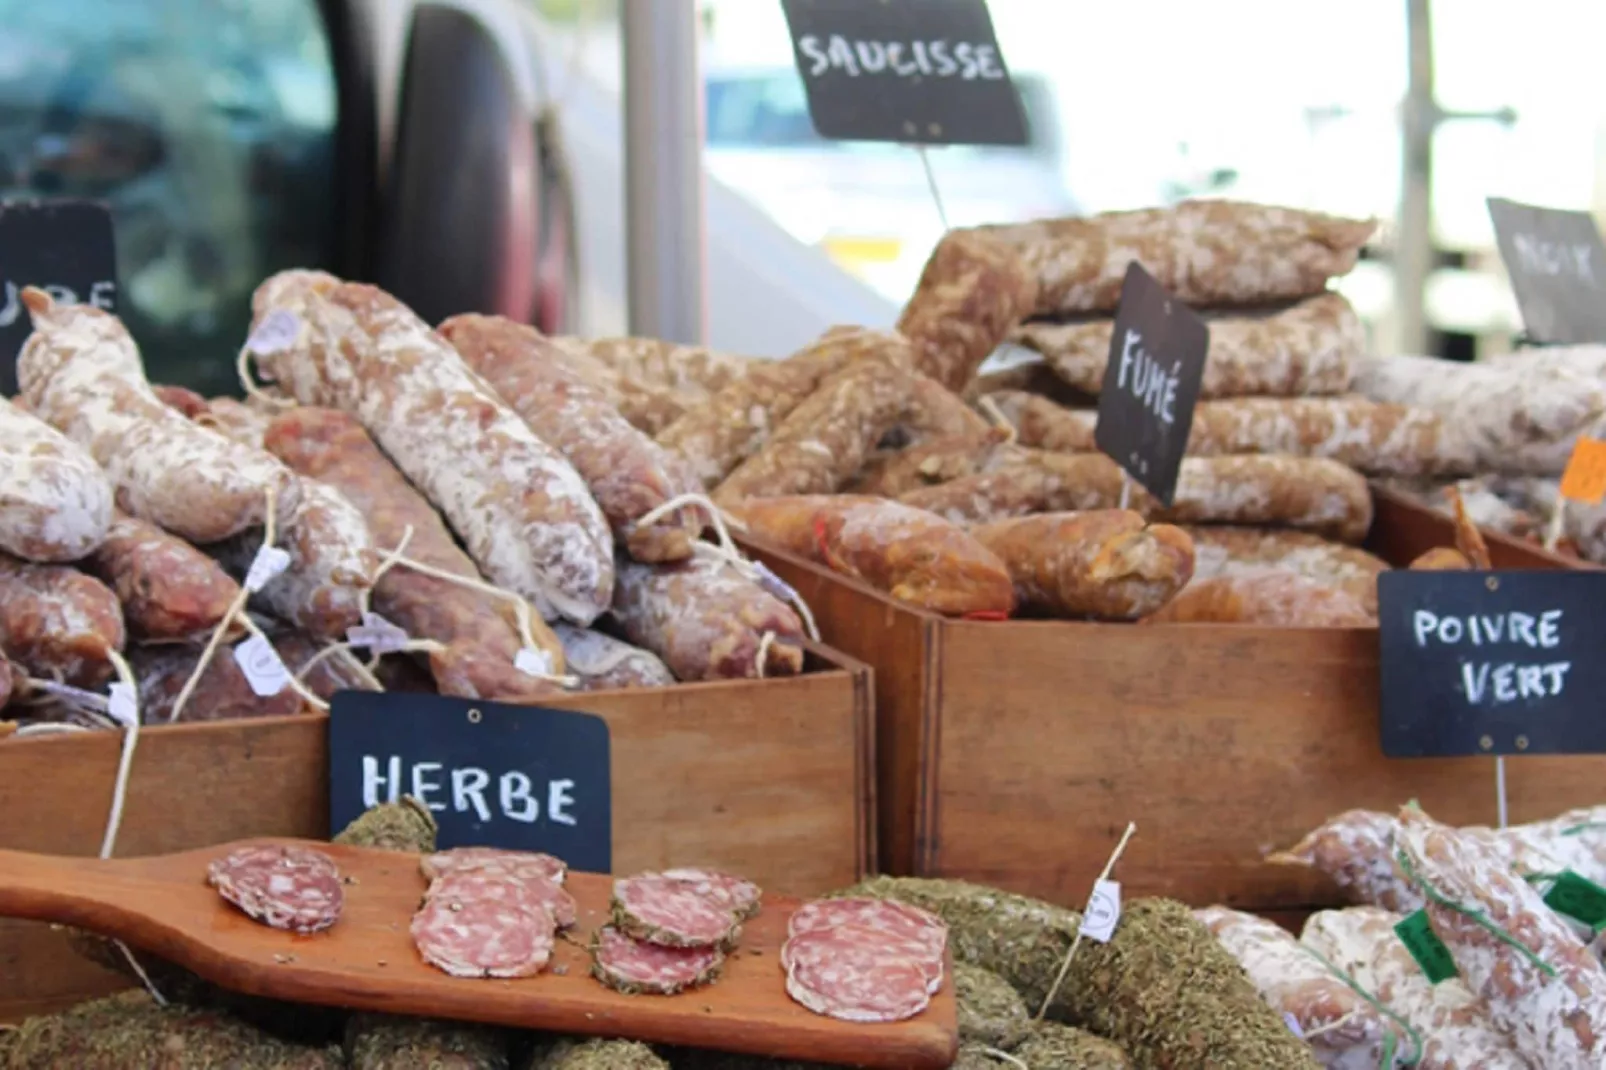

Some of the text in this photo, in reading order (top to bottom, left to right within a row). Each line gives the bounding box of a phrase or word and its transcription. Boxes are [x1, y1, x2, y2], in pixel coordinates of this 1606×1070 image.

[799, 34, 1004, 80] SAUCISSE
[1117, 327, 1182, 424] FUMÉ
[1413, 608, 1563, 648] POIVRE
[1462, 660, 1572, 705] VERT
[361, 754, 577, 826] HERBE
